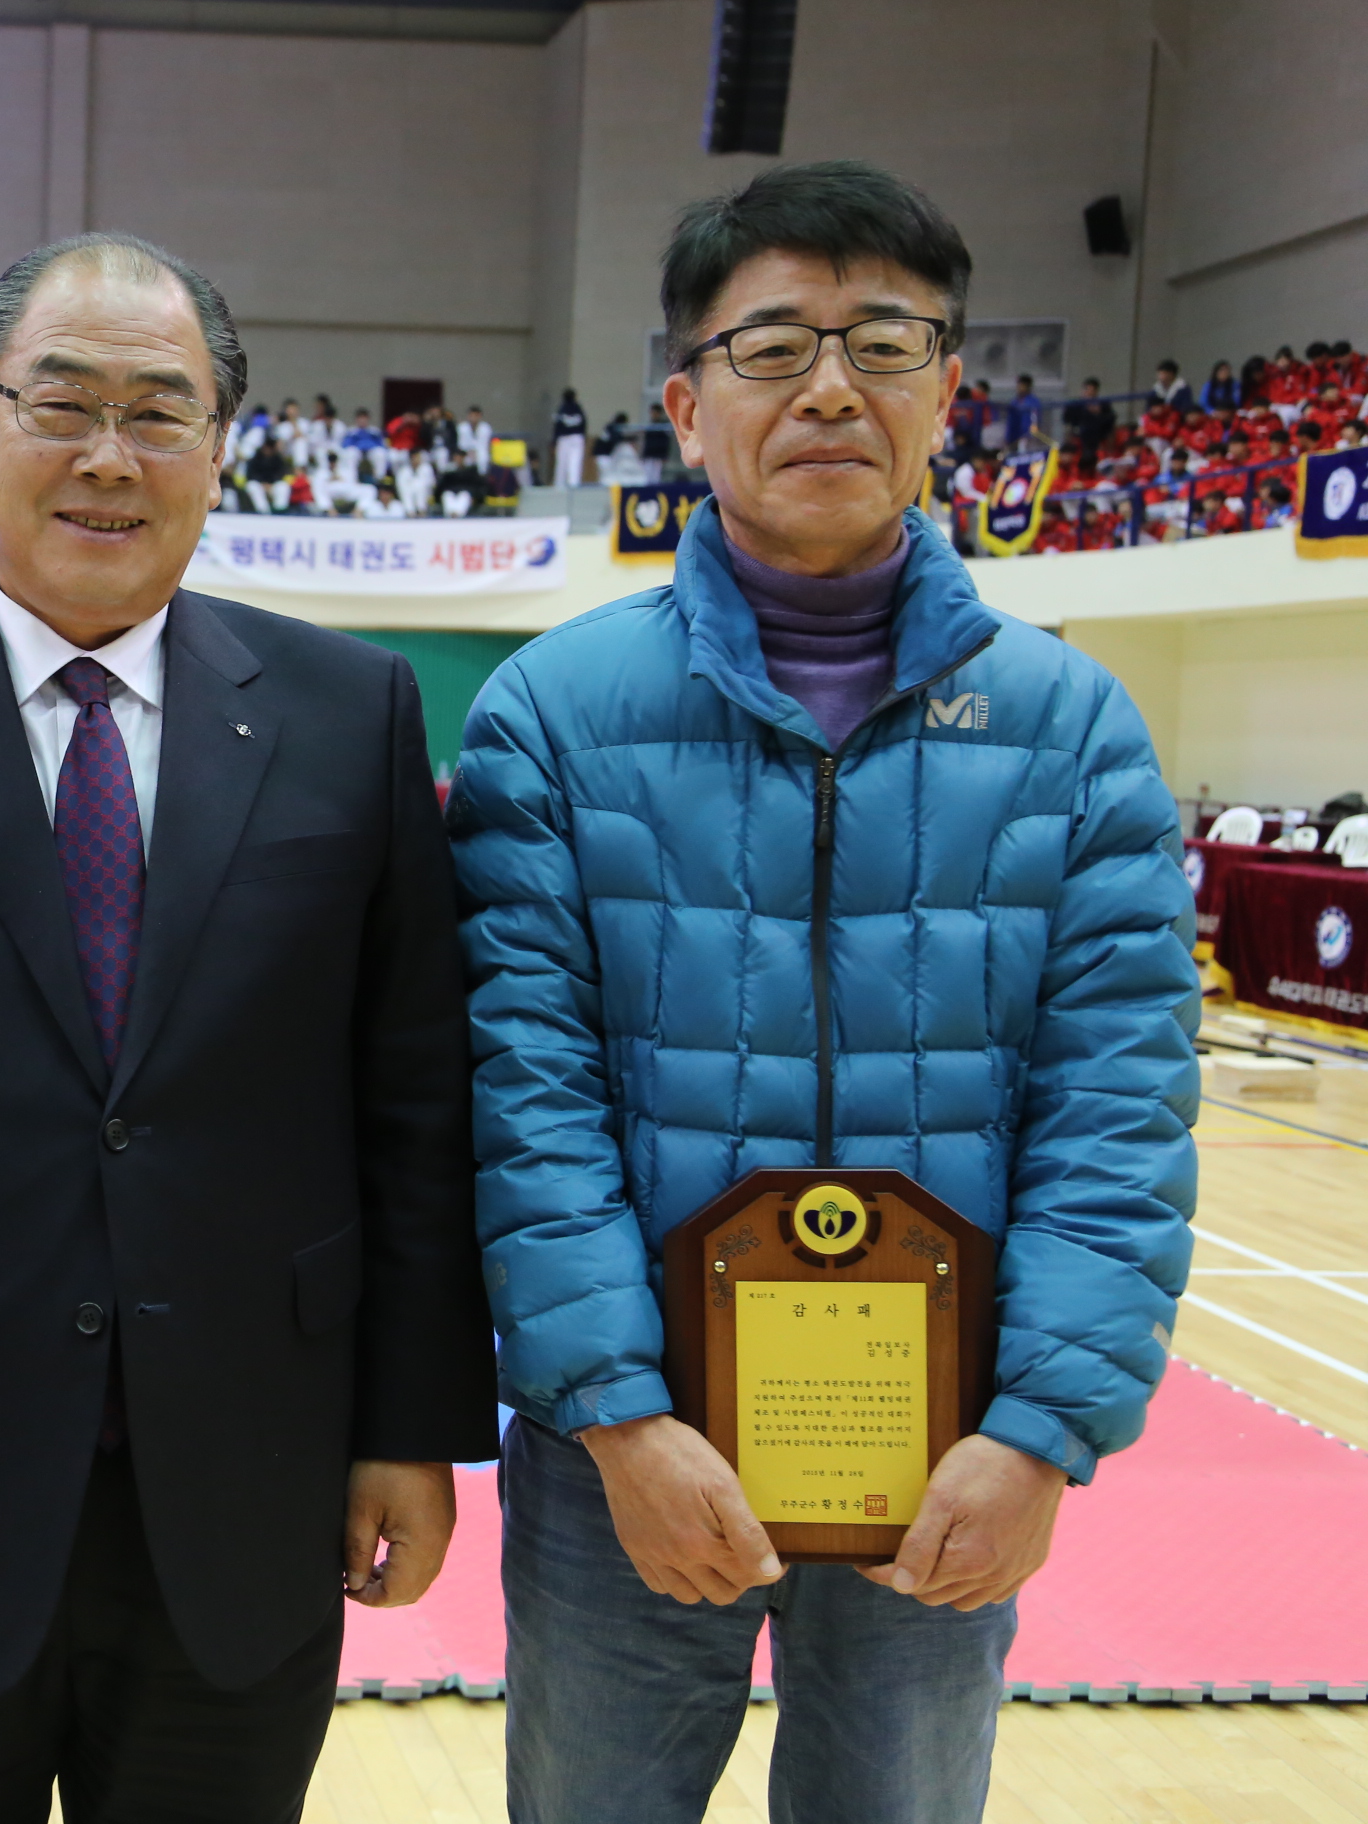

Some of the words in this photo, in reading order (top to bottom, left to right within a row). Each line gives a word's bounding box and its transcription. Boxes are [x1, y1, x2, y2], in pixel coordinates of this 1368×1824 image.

[230, 536, 316, 570] 평택시
[327, 540, 416, 571] 태권도
[429, 540, 516, 572] 시범단
[979, 694, 989, 729] MILLET
